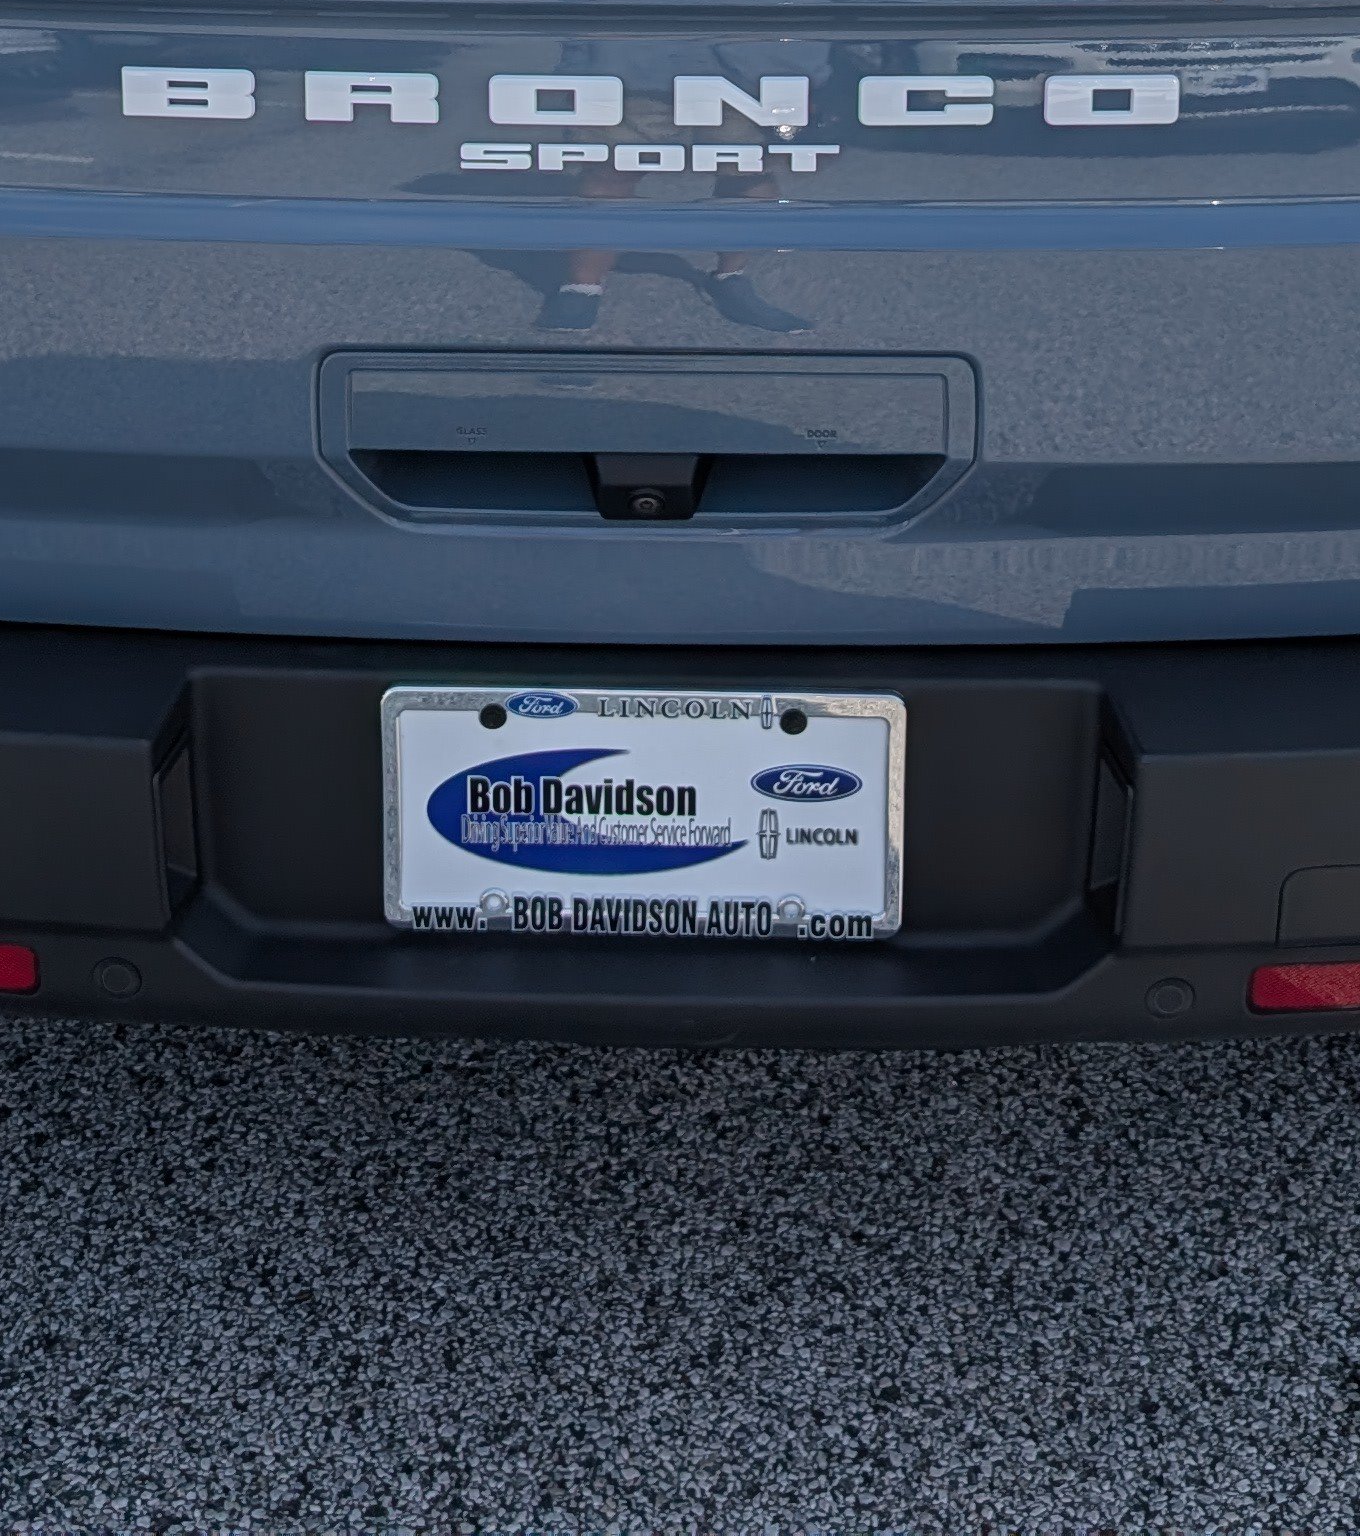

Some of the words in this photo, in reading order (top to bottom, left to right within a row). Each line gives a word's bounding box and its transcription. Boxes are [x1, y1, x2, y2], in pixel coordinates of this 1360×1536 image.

[122, 66, 1180, 126] BRONCO
[460, 143, 839, 172] SPORT
[518, 695, 564, 715] Ford
[597, 697, 753, 720] LINCOLN
[468, 776, 535, 814] Bob
[541, 777, 697, 816] Davidson
[773, 770, 840, 795] Ford
[461, 814, 499, 852] Driving
[500, 814, 544, 852] Superior
[599, 817, 648, 845] Customer
[650, 817, 687, 846] Service
[688, 817, 732, 846] Forward
[786, 827, 859, 845] LINCOLN
[411, 905, 487, 930] www.
[513, 896, 563, 931] BOB
[572, 897, 697, 934] DAVIDSON
[705, 900, 772, 936] AUTO
[797, 913, 874, 939] .com
